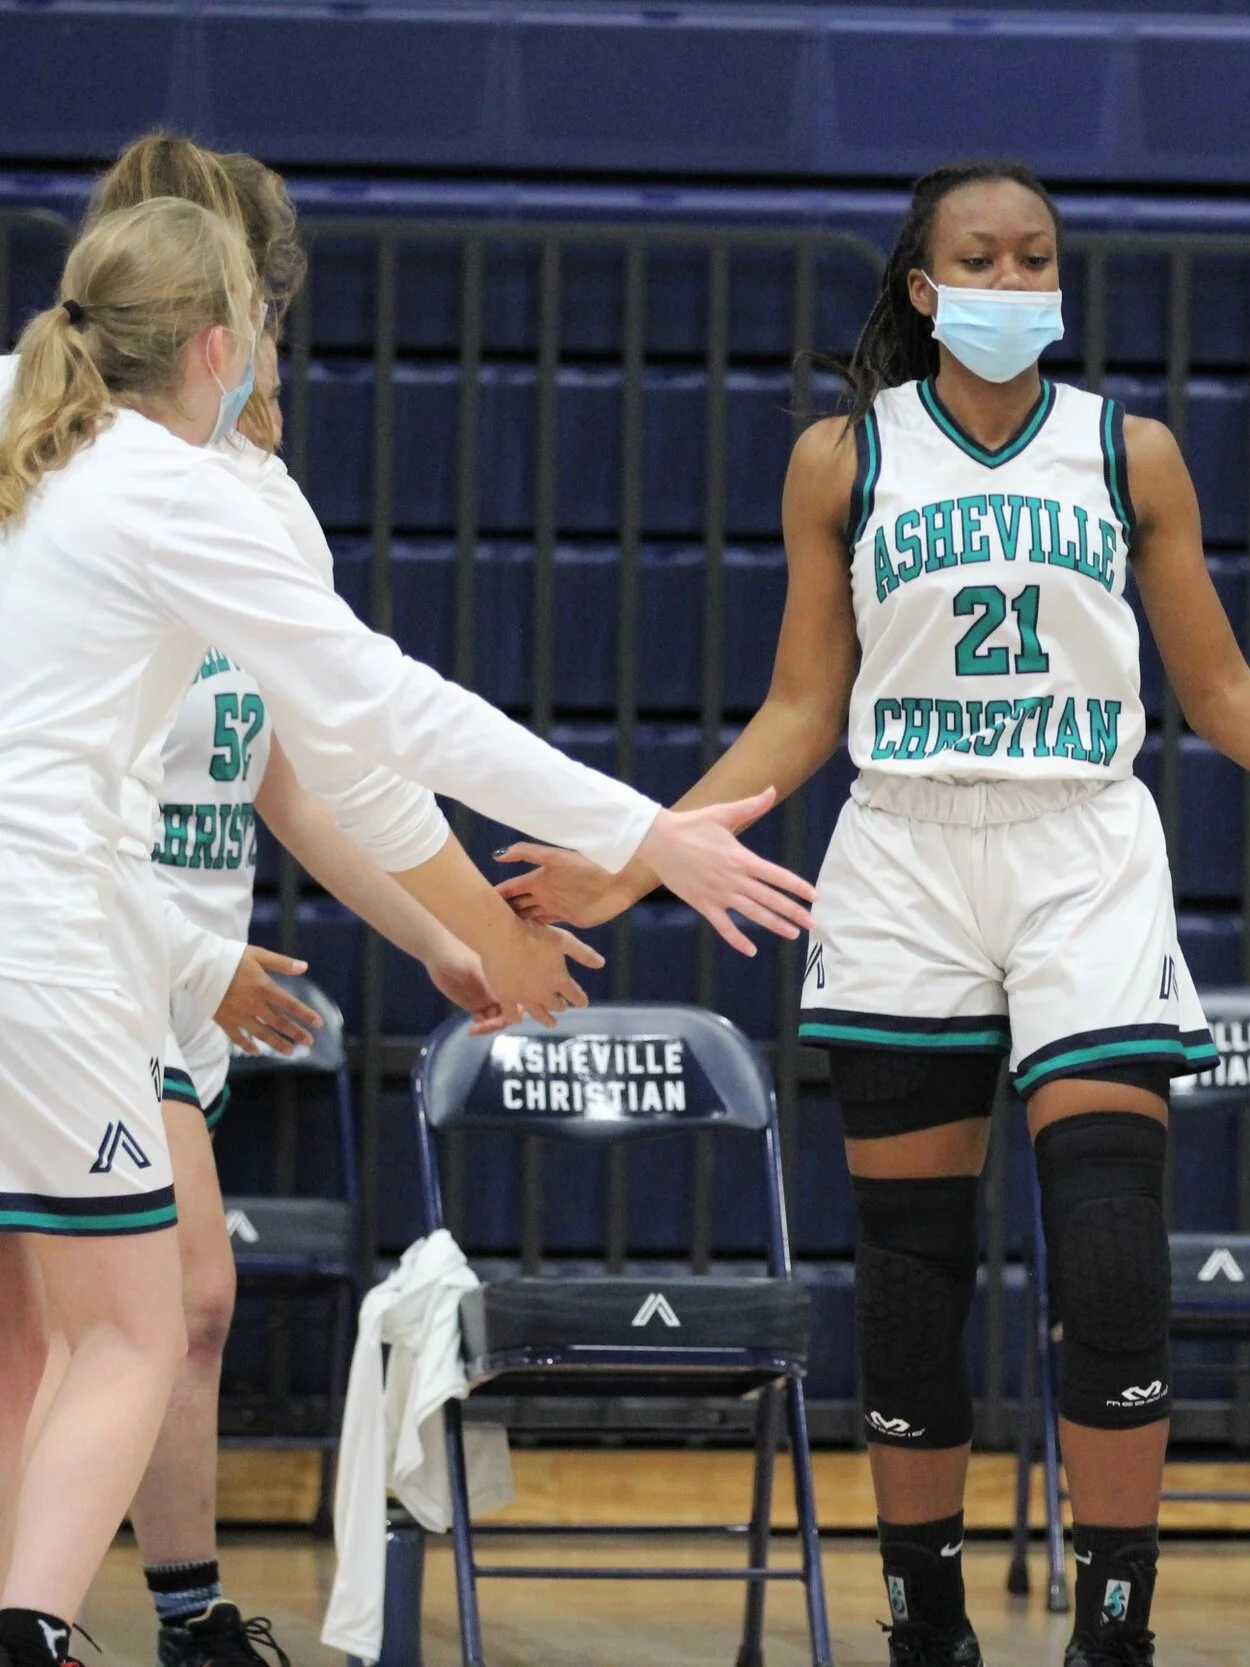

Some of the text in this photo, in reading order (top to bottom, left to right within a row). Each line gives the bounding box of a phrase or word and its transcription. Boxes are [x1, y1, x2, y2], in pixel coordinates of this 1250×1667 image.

[874, 494, 1117, 604] ASHEVILLE
[953, 585, 1050, 677] 21
[208, 692, 265, 782] 52
[871, 695, 1122, 767] CHRISTIAN
[502, 1042, 684, 1076] ASHEVILLE
[502, 1077, 687, 1113] CHRISTIAN
